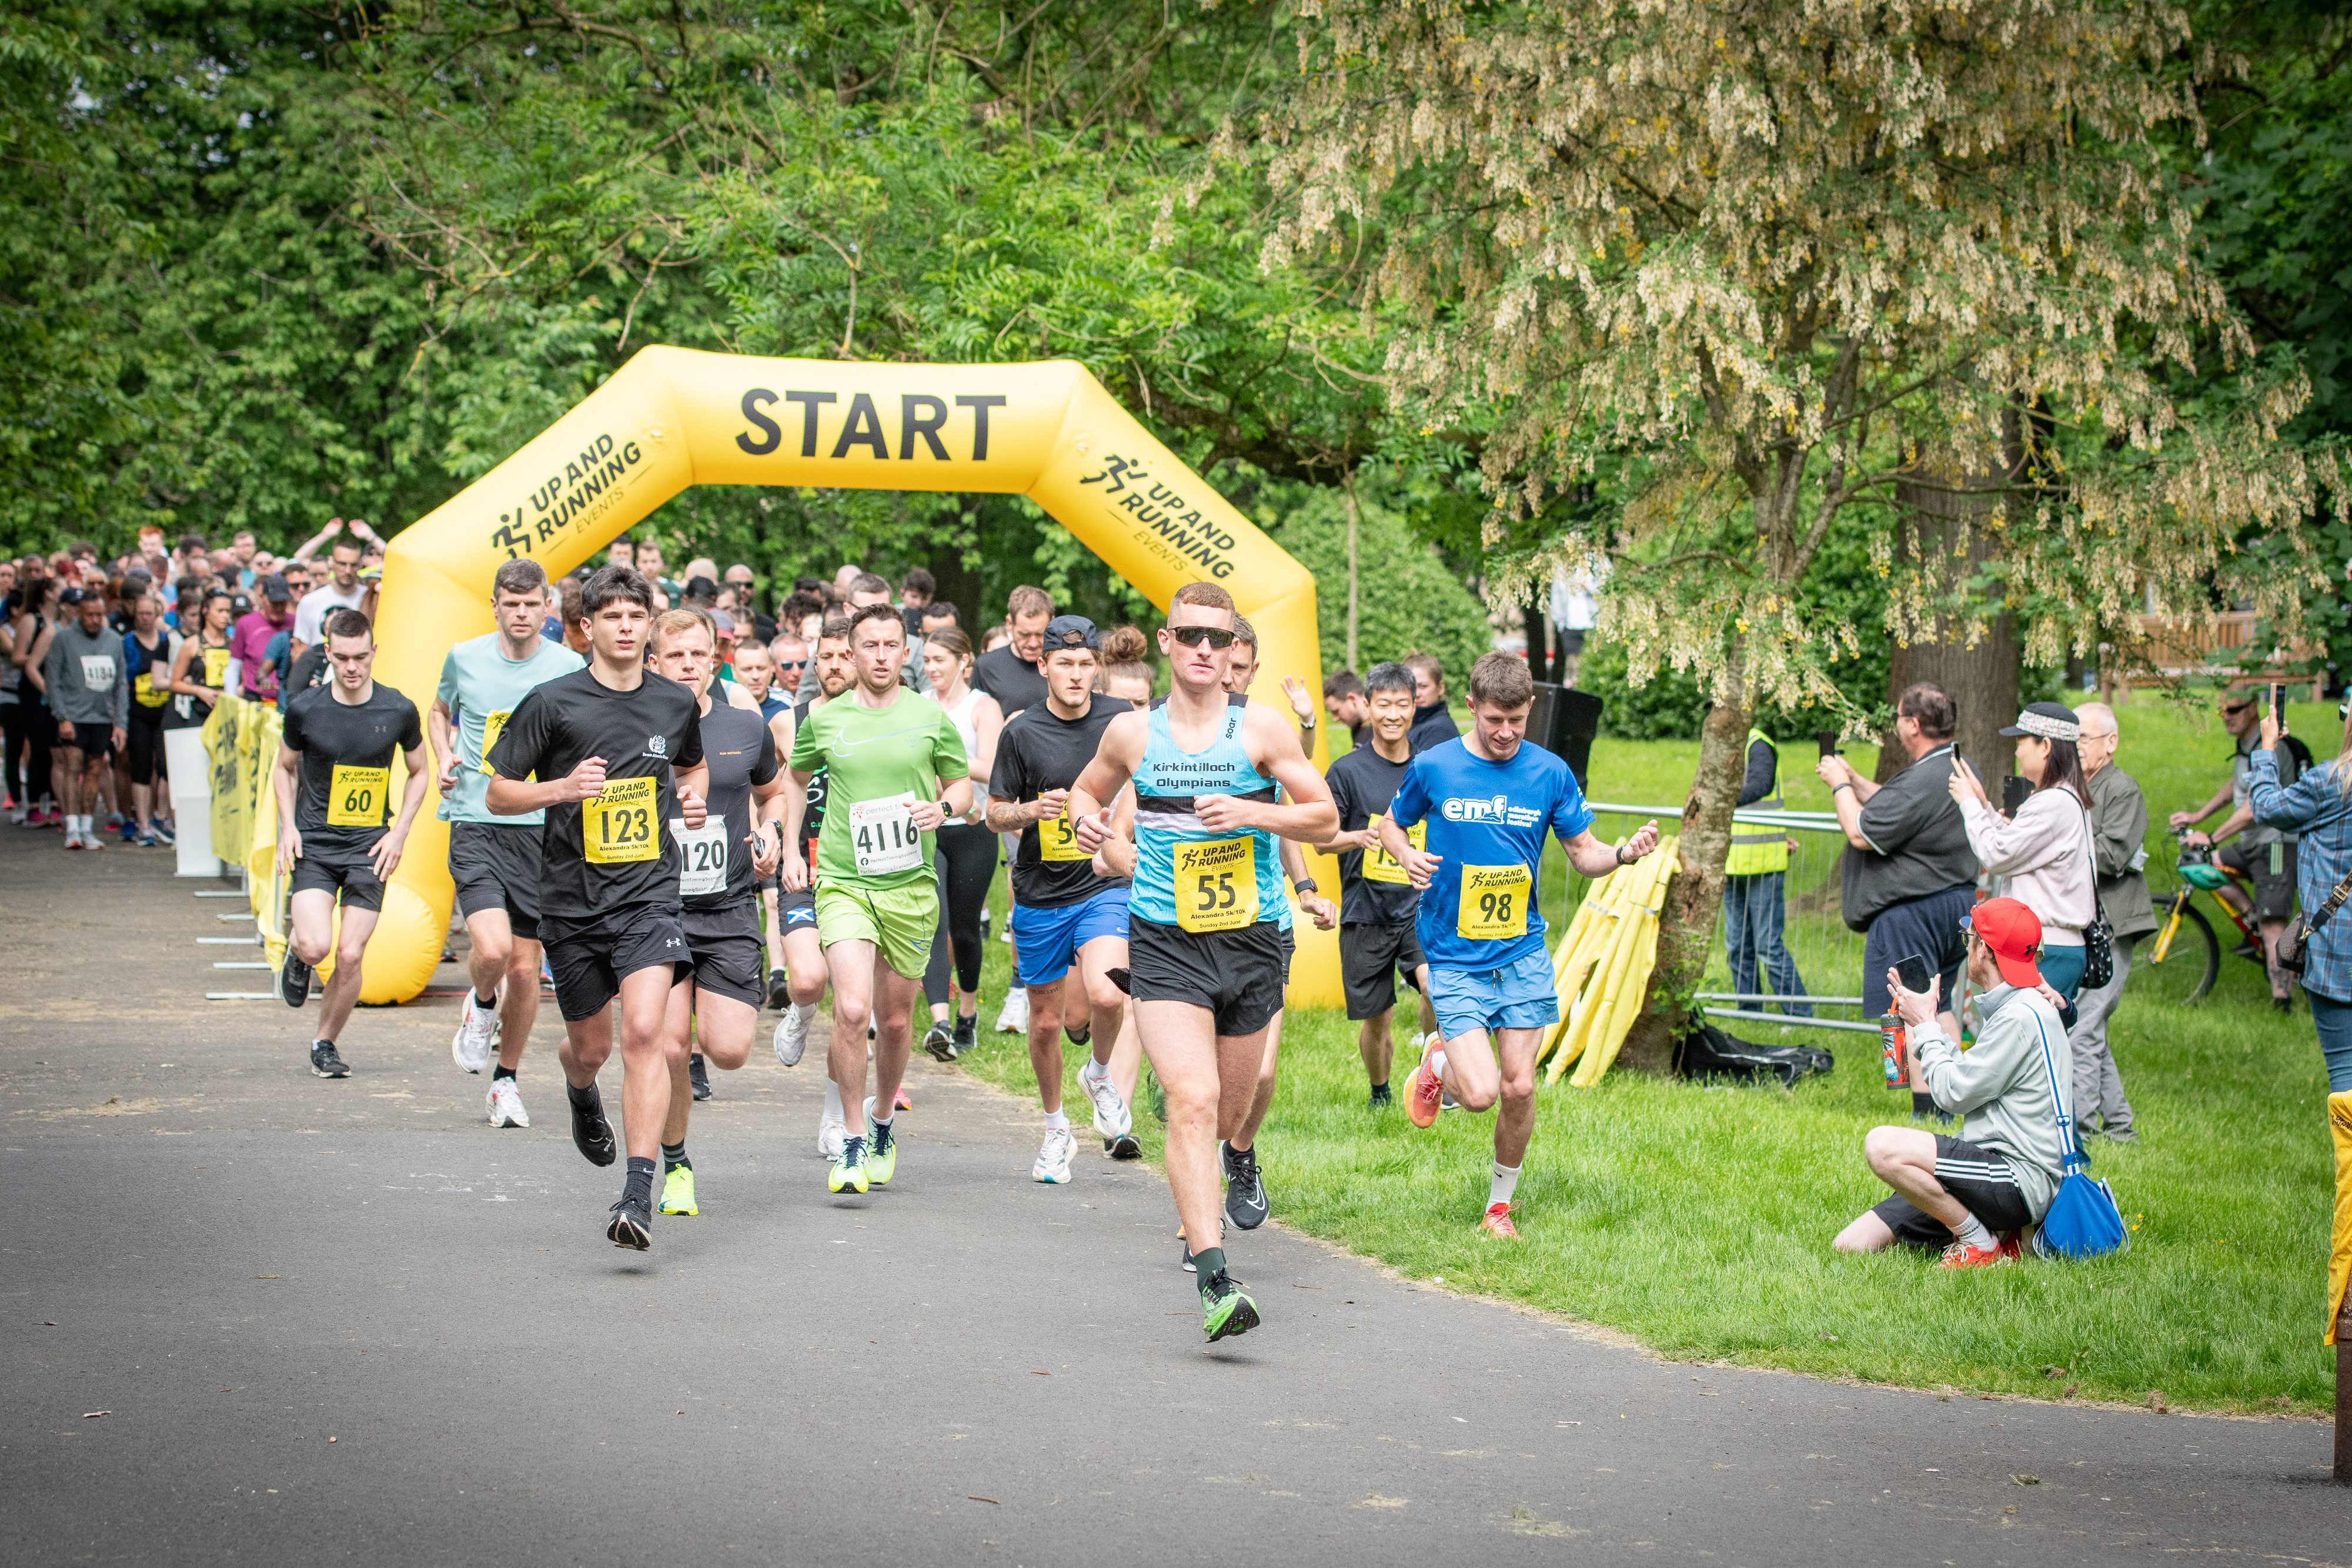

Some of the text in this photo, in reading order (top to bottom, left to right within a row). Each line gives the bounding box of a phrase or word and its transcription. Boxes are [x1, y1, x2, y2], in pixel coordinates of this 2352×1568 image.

[735, 388, 1006, 461] START
[530, 434, 613, 511] UP AND
[536, 442, 640, 543] RUNNING
[576, 487, 624, 533] EVENTS
[1148, 482, 1235, 550] UP AND
[1119, 492, 1234, 579] RUNNING
[1134, 531, 1188, 571] EVENTS
[1225, 718, 1236, 739] soar
[1153, 763, 1235, 772] Kirkintilloch
[612, 781, 646, 794] UP AND
[1157, 778, 1230, 789] Olympians
[345, 789, 371, 812] 60
[607, 789, 649, 803] RUNNING
[866, 805, 893, 814] perfect
[1442, 795, 1507, 824] emf
[1507, 806, 1542, 817] edinburgh
[1507, 813, 1539, 823] marathon
[602, 808, 649, 844] 123
[1506, 818, 1532, 828] festival
[857, 817, 918, 854] 4116
[870, 850, 917, 862] PerfectTimingScotland
[1198, 849, 1245, 867] RUNNING
[1203, 842, 1241, 857] UP AND
[1211, 862, 1234, 872] EVENTS
[1502, 869, 1523, 878] AND
[1484, 876, 1526, 887] RUNNING
[1198, 872, 1235, 911] 55
[1480, 893, 1512, 922] 98
